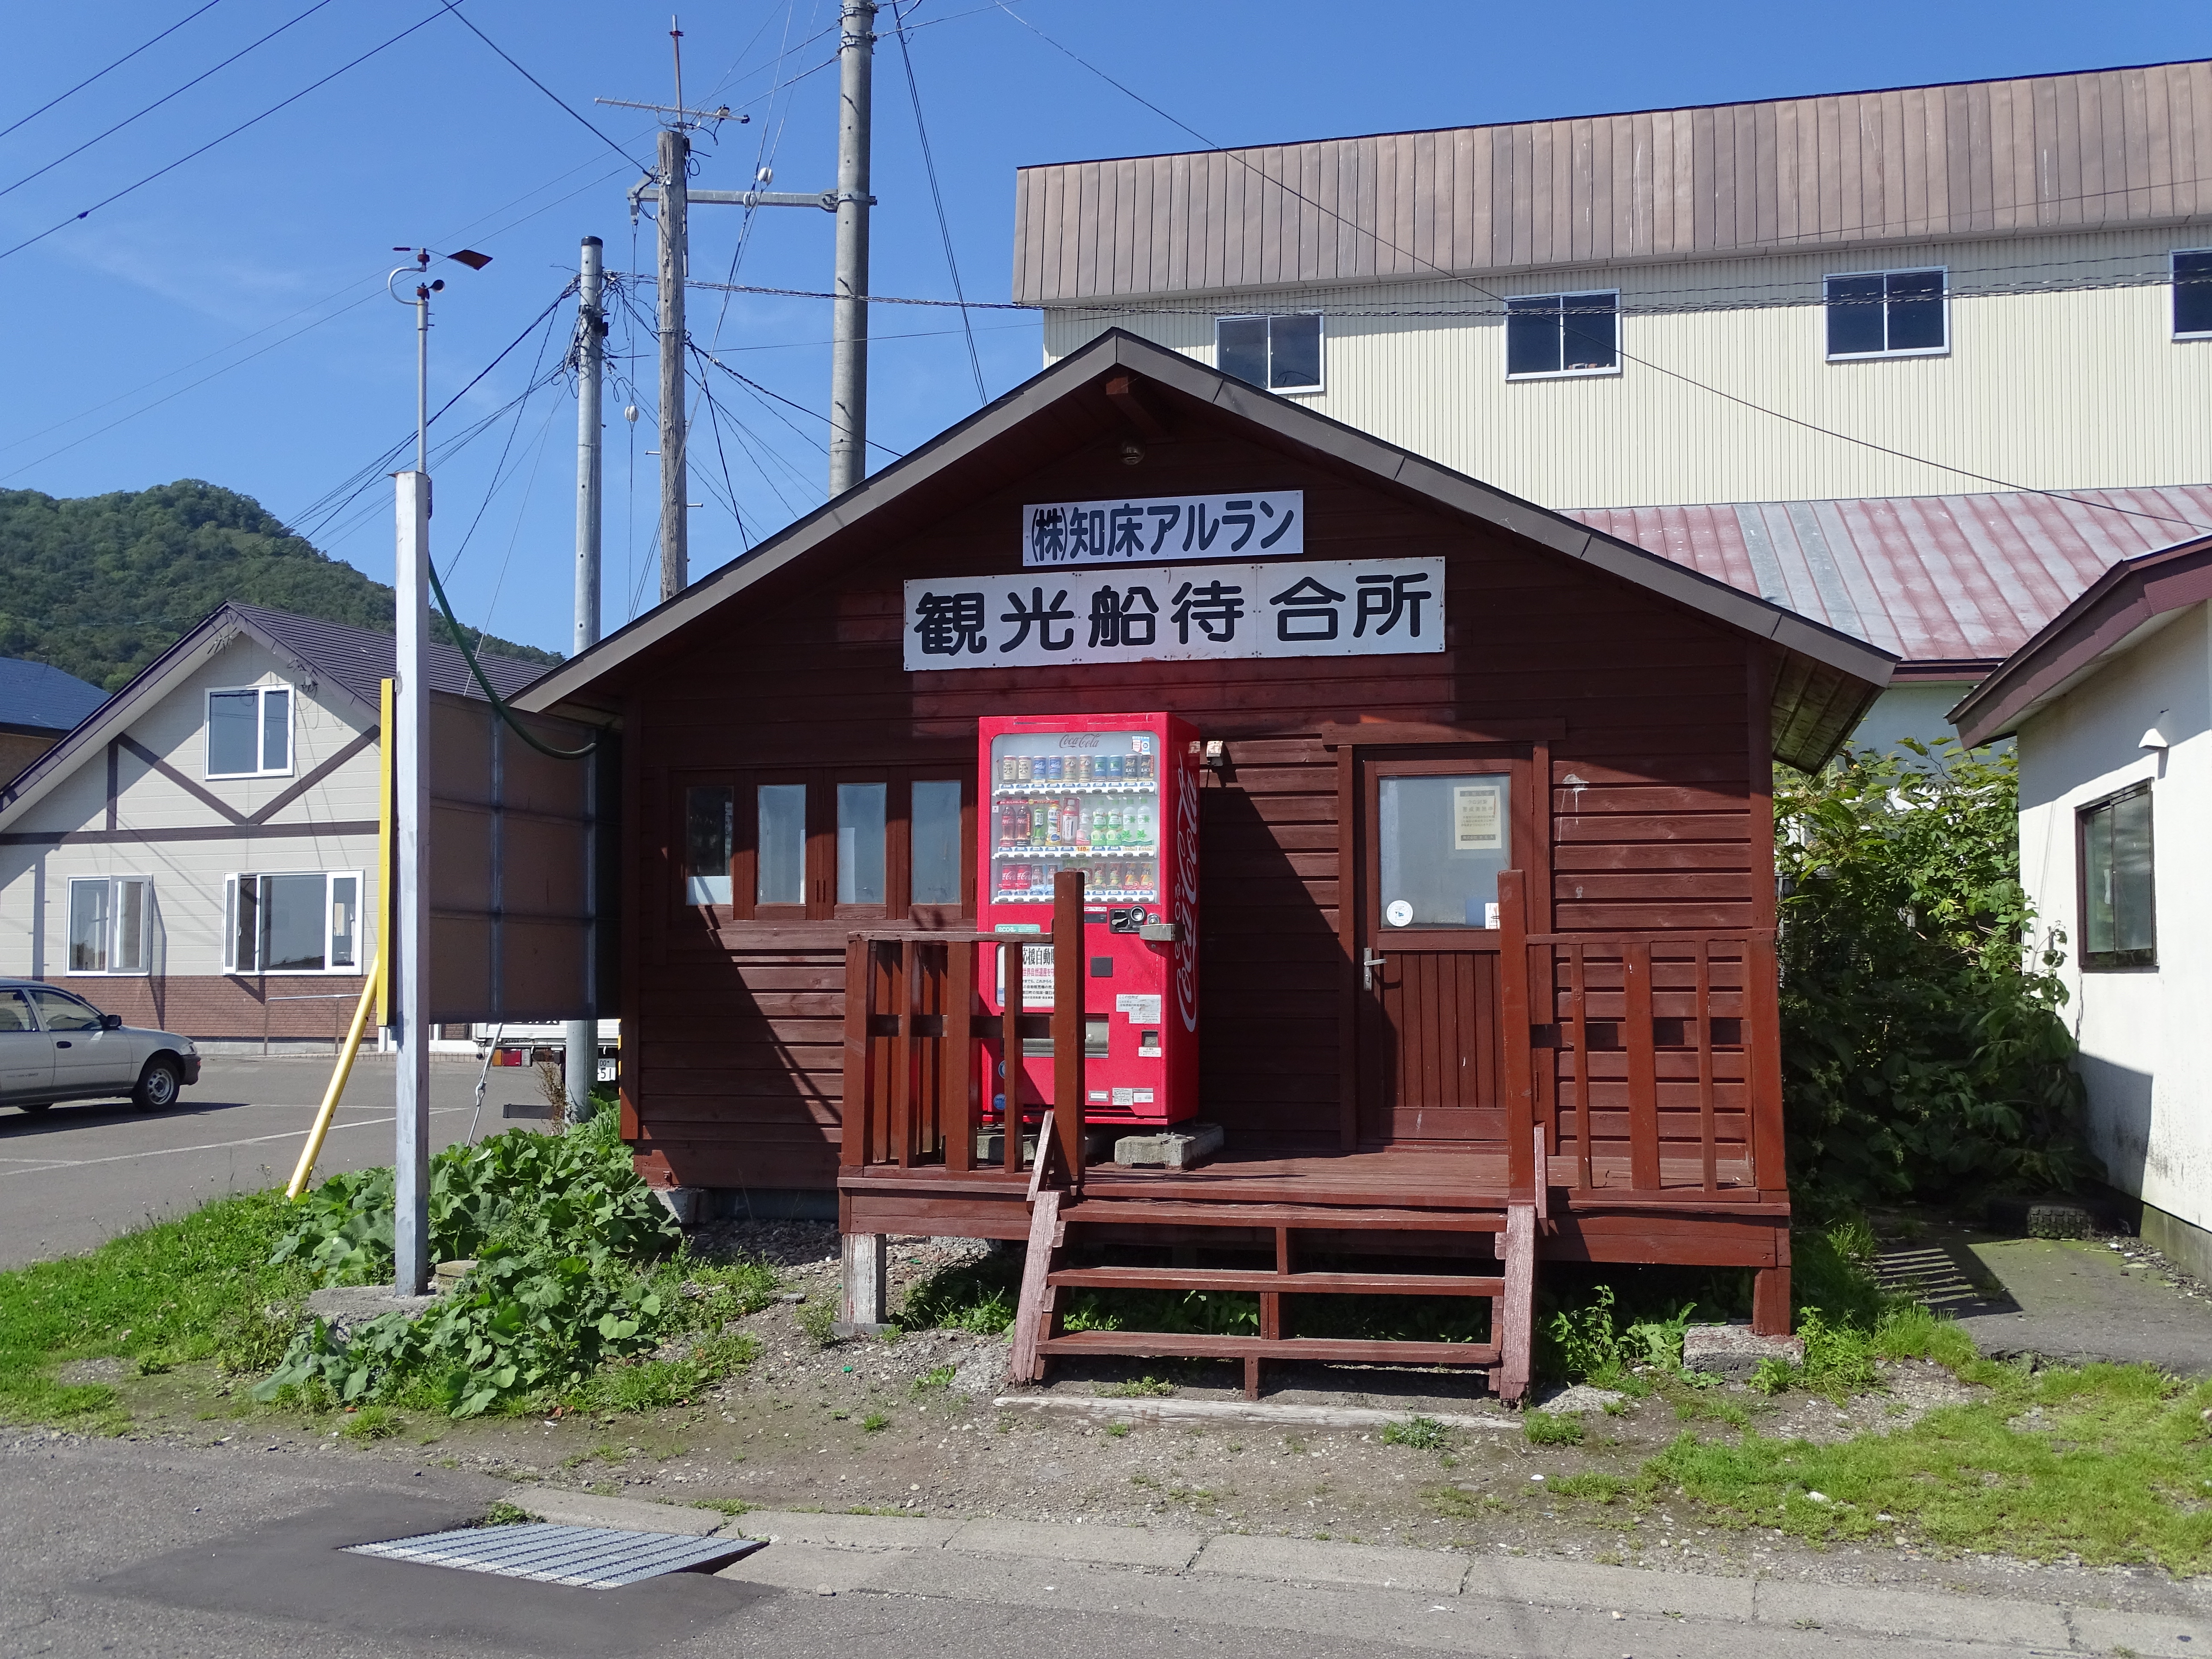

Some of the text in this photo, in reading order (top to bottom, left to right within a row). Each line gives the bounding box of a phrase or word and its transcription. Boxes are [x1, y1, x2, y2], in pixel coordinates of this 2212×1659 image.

[1031, 500, 1294, 562] (株)知床アルラン
[914, 572, 1433, 655] 観光船待合所
[1059, 733, 1101, 748] Coca-Cola
